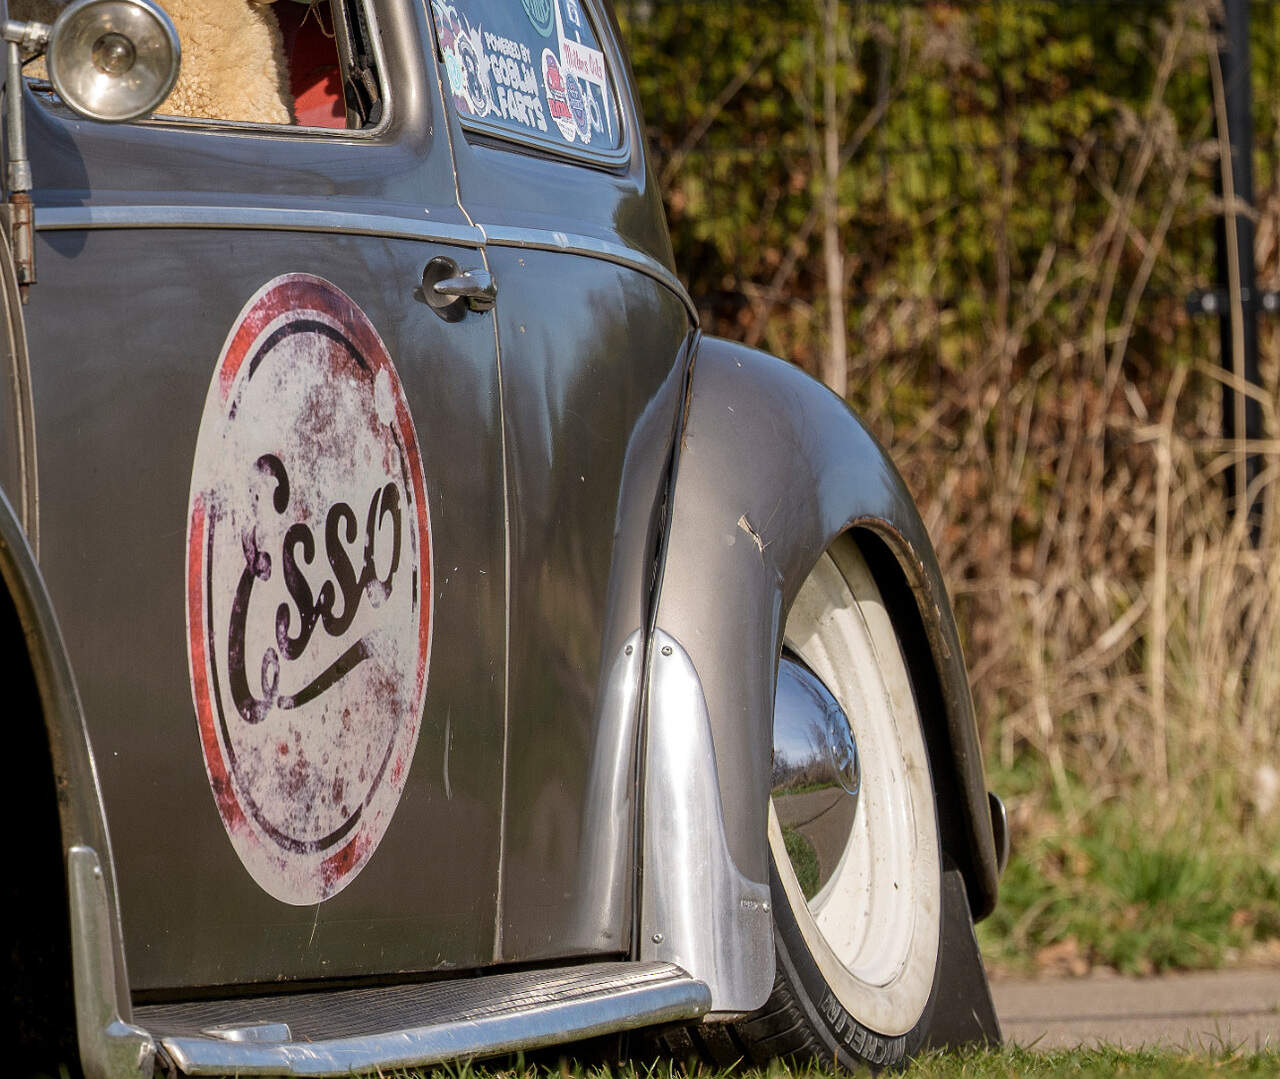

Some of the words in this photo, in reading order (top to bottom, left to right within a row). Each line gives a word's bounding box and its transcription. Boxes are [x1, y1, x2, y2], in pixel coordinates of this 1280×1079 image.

[484, 32, 521, 60] POWERED
[520, 43, 531, 64] BY
[490, 54, 538, 97] GOBLIN
[497, 86, 547, 132] FARTS
[228, 453, 402, 724] Esso
[820, 994, 906, 1066] MICHELIN
